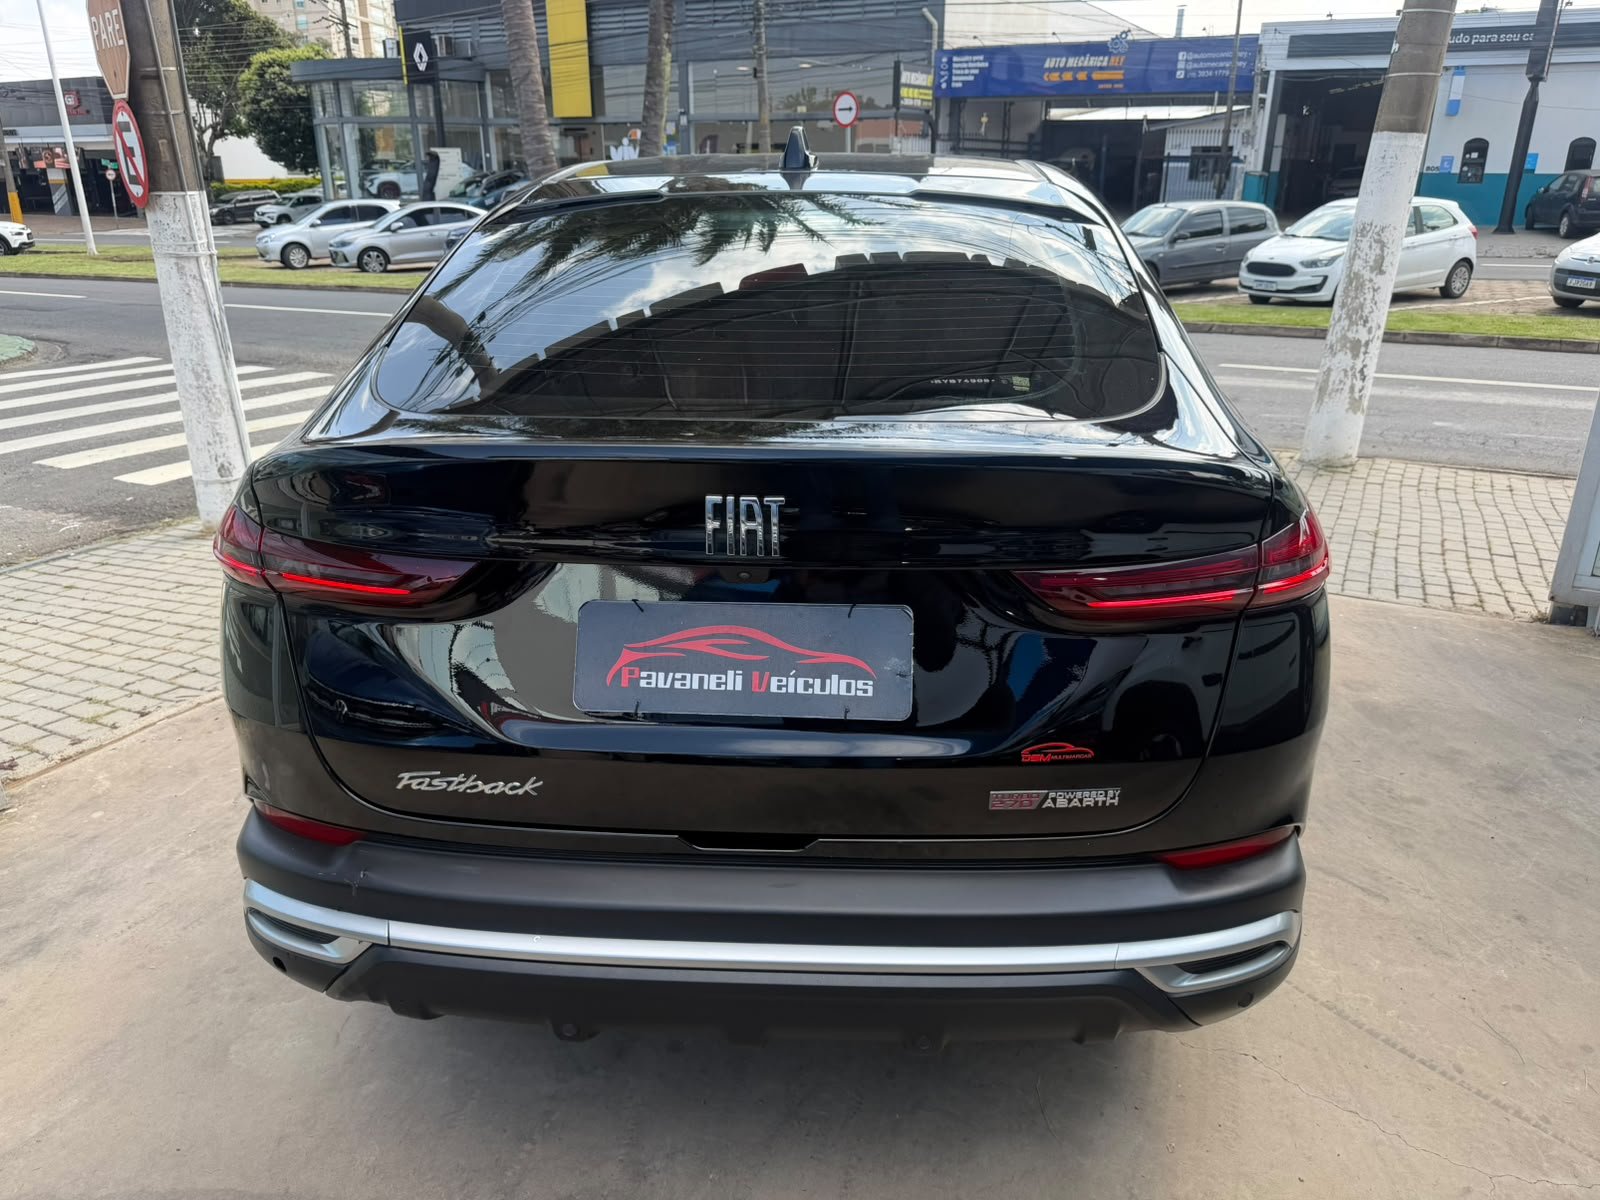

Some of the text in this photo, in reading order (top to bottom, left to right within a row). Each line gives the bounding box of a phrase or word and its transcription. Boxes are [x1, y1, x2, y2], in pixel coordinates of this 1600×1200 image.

[91, 9, 124, 51] PARE
[1449, 33, 1470, 43] udo
[1471, 32, 1497, 45] para
[1500, 33, 1520, 42] seu
[1044, 57, 1067, 69] AUTO
[1066, 53, 1109, 68] MECÂNICA
[705, 495, 785, 557] FIAT
[621, 667, 873, 697] Pavaneli Veículos
[396, 771, 543, 796] Fastback
[1041, 797, 1119, 809] ABARTH
[1049, 789, 1120, 799] POWERED BY
